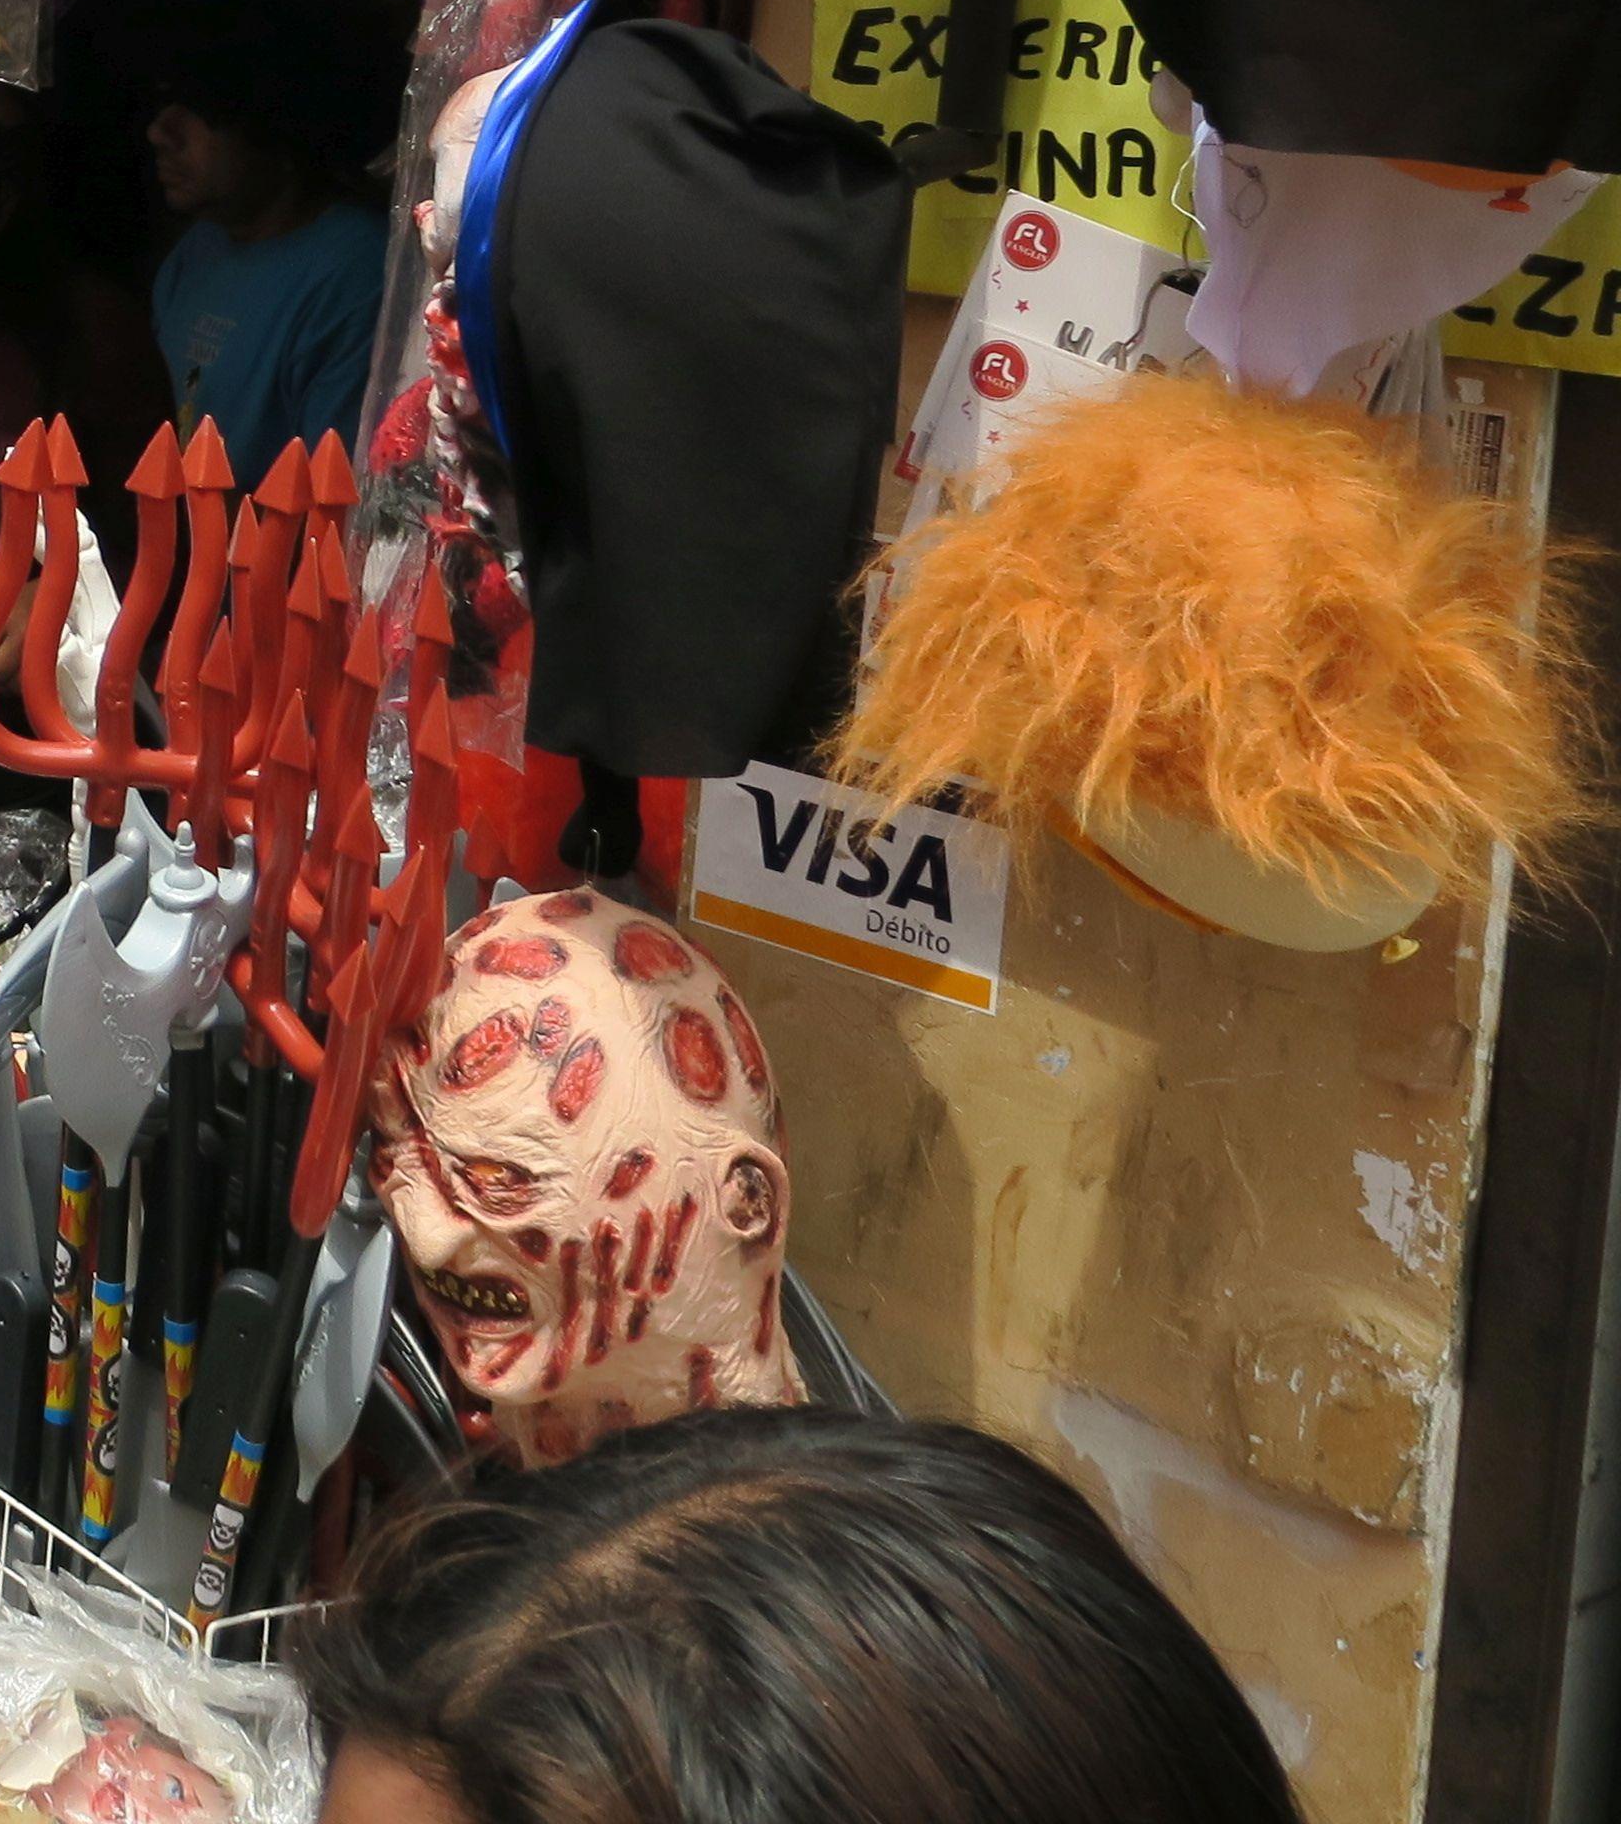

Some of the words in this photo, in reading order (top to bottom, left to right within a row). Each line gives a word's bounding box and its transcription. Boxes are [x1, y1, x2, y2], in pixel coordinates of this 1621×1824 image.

[832, 7, 1155, 86] EXERI
[1013, 223, 1048, 254] FL
[981, 351, 1017, 383] FL
[736, 782, 953, 924] VISA
[866, 909, 951, 954] Débito
